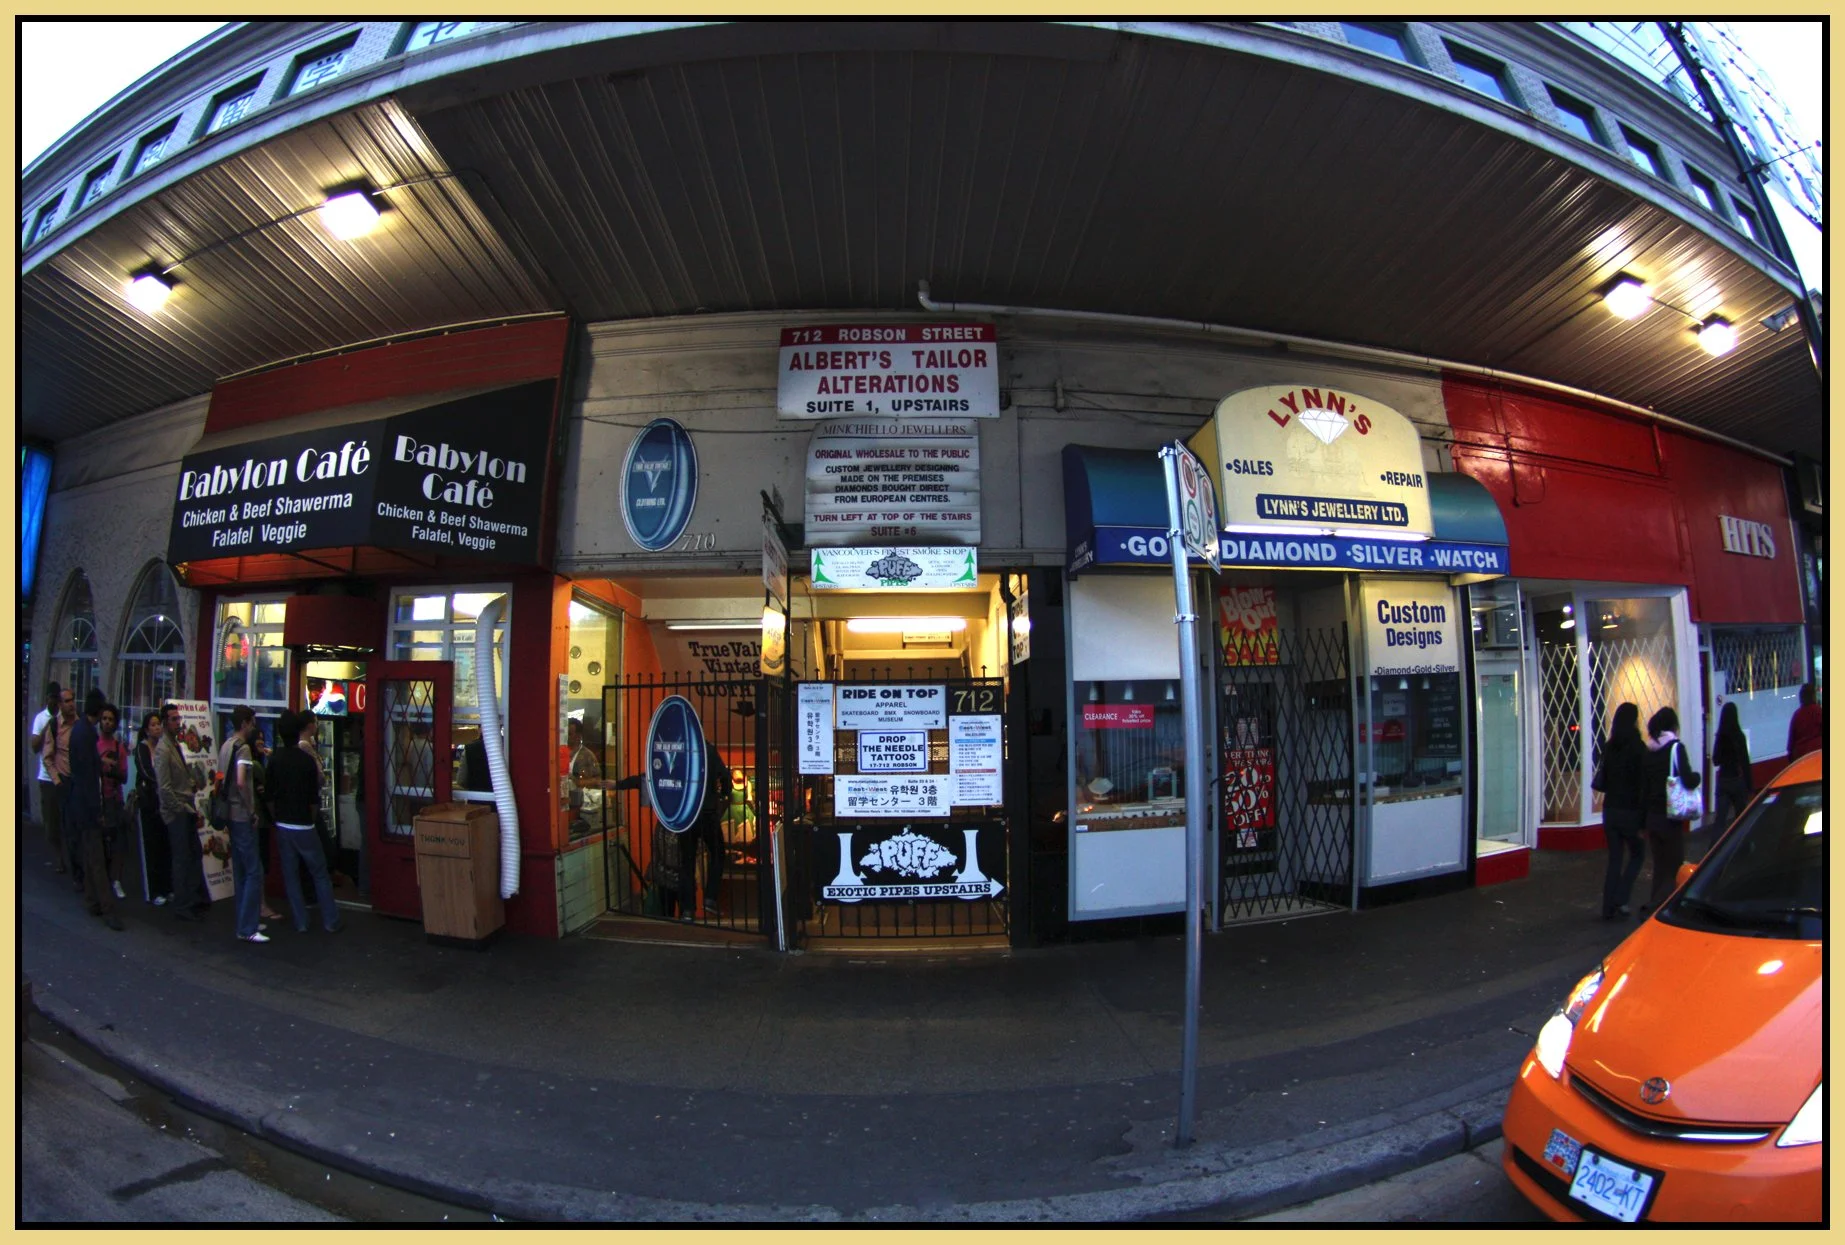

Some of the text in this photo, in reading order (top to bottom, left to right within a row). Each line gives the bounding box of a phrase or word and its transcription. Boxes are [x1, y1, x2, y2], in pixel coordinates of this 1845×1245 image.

[792, 327, 983, 343] 712 ROBSON STREET
[789, 349, 987, 371] ALBERT'S TAILOR
[817, 374, 960, 394] ALTERATIONS
[806, 399, 969, 414] SUITE 1, UPSTAIRS
[1267, 388, 1372, 436] LYNN'S
[823, 424, 966, 436] MINICHIELLO JEWELLERS
[394, 435, 527, 483] Babylon
[815, 449, 970, 459] ORIGINAL WHOLESALE TO THE PUBLIC
[180, 440, 371, 501] Babylon Café
[825, 464, 960, 473] CUSTOM JEWELLERY DESIGNING
[1233, 458, 1274, 476] SALES
[902, 474, 944, 482] PREMISES
[1386, 471, 1424, 488] REPAIR
[422, 473, 494, 508] Café
[835, 485, 879, 493] DIAMONDS
[919, 484, 950, 492] DIRECT
[834, 495, 950, 503] FROM EUROPEAN CENTRES.
[182, 492, 353, 528] Chicken & Beef Shawerma
[814, 514, 838, 522] TURN
[841, 513, 863, 521] LEFT
[1264, 498, 1405, 522] LYNN'S JEWELLERY LTD.
[377, 502, 528, 537] Chicken & Beef Shawerma
[212, 522, 307, 548] Falafel Veggie
[412, 525, 496, 550] Falafel, Veggie
[871, 527, 900, 537] SUITE
[1718, 515, 1776, 559] HITS
[681, 533, 715, 550] 710
[881, 548, 910, 556] FINEST
[1222, 539, 1337, 562] DIAMOND
[1351, 544, 1423, 566] SILVER
[1434, 548, 1499, 569] WATCH
[1377, 599, 1447, 624] Custom
[1386, 627, 1442, 649] Designs
[1225, 643, 1279, 665] SALE
[702, 659, 762, 677] Vintag
[1376, 664, 1456, 676] Diamond Gold Silver
[842, 689, 938, 699] RIDE ON TOP
[954, 690, 994, 712] 712
[871, 753, 916, 762] TATTOOS
[848, 797, 911, 806] 留学センター
[420, 834, 445, 843] THANK
[880, 839, 938, 868] PUFF
[827, 884, 991, 897] EXOTIC PIPES UPSTAIRS
